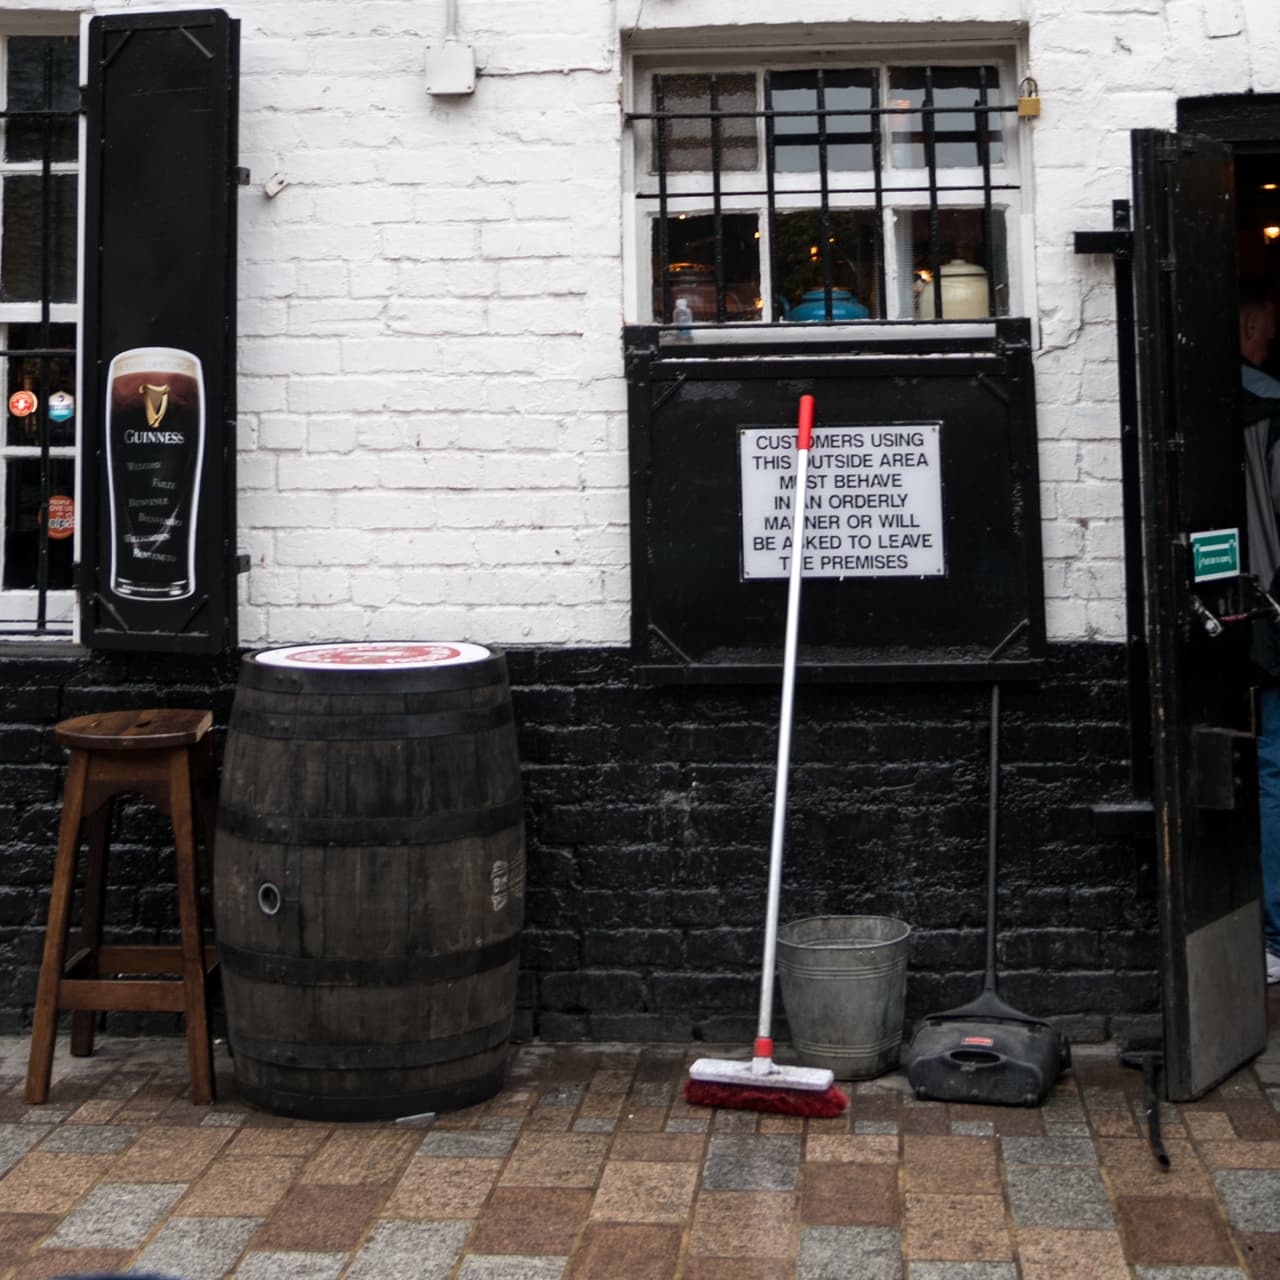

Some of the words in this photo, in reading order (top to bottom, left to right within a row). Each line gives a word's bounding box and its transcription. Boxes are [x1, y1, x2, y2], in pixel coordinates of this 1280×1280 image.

[124, 429, 185, 444] GUINNESS
[871, 433, 924, 447] USING
[752, 455, 792, 470] THIS
[807, 454, 873, 469] UTSIDE
[880, 453, 929, 467] AREA
[780, 474, 828, 489] MST
[834, 473, 902, 488] BEHAVE
[775, 496, 790, 510] IN
[828, 494, 908, 509] ORDERLY
[764, 515, 840, 530] MANER
[847, 514, 872, 529] OR
[879, 513, 920, 528] WILL
[754, 536, 776, 551] BE
[782, 535, 841, 550] AKED
[848, 535, 871, 549] TO
[879, 533, 933, 548] LEAVE
[779, 556, 814, 571] TE
[821, 554, 908, 570] PREMISES
